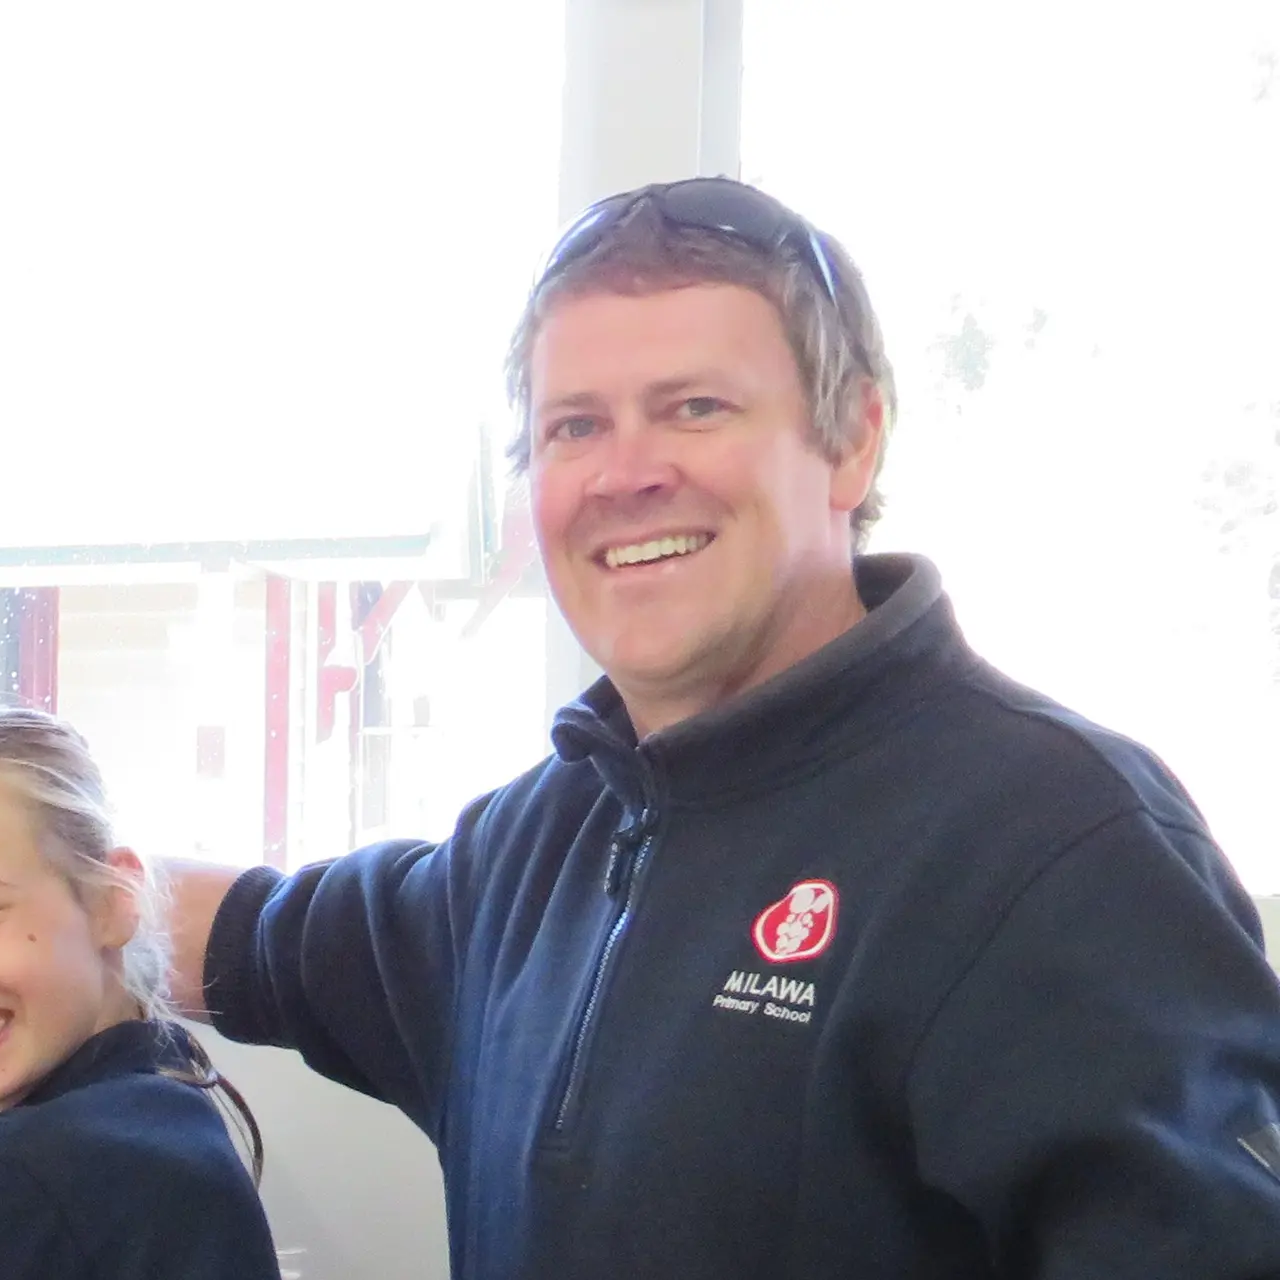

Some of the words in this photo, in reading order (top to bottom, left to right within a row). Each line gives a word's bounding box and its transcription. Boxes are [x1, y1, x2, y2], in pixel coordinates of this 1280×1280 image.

[724, 970, 816, 1006] MILAWA
[713, 994, 759, 1014] Primary
[763, 1002, 811, 1023] School
